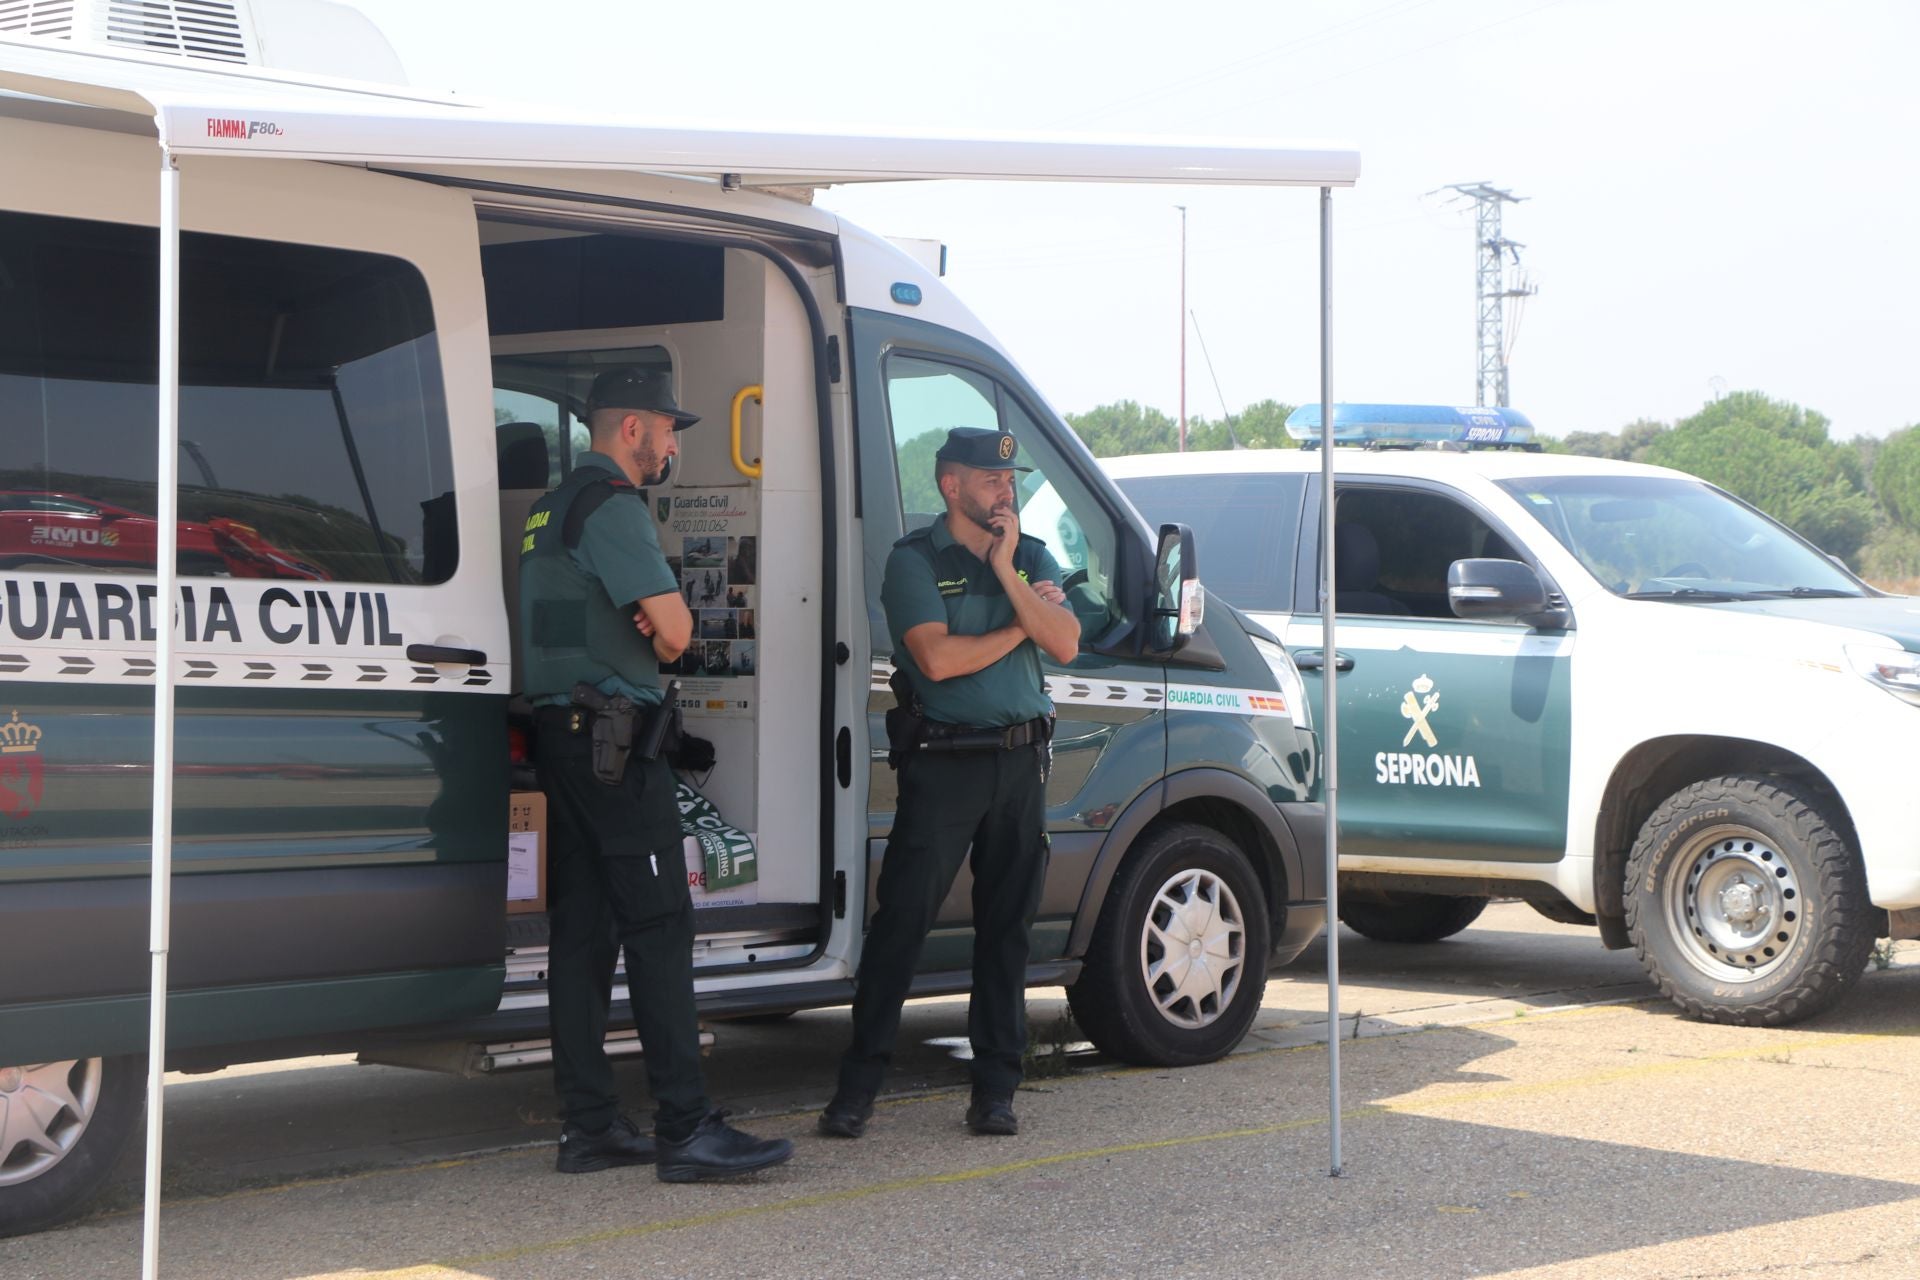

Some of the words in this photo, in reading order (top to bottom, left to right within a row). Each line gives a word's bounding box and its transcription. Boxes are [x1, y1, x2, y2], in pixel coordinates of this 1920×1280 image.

[207, 118, 246, 139] FIAMMA
[1466, 427, 1503, 441] SEPRONA
[674, 496, 708, 508] Guardia
[709, 495, 729, 508] Civil
[673, 520, 691, 532] 900
[692, 520, 707, 532] 101
[709, 520, 729, 532] 062
[0, 580, 242, 643] UARDIA
[258, 587, 402, 646] CIVIL
[1168, 690, 1214, 705] GUARDIA
[1216, 694, 1241, 708] CIVIL
[1375, 752, 1481, 787] SEPRONA
[1645, 807, 1729, 894] BFGoodrich
